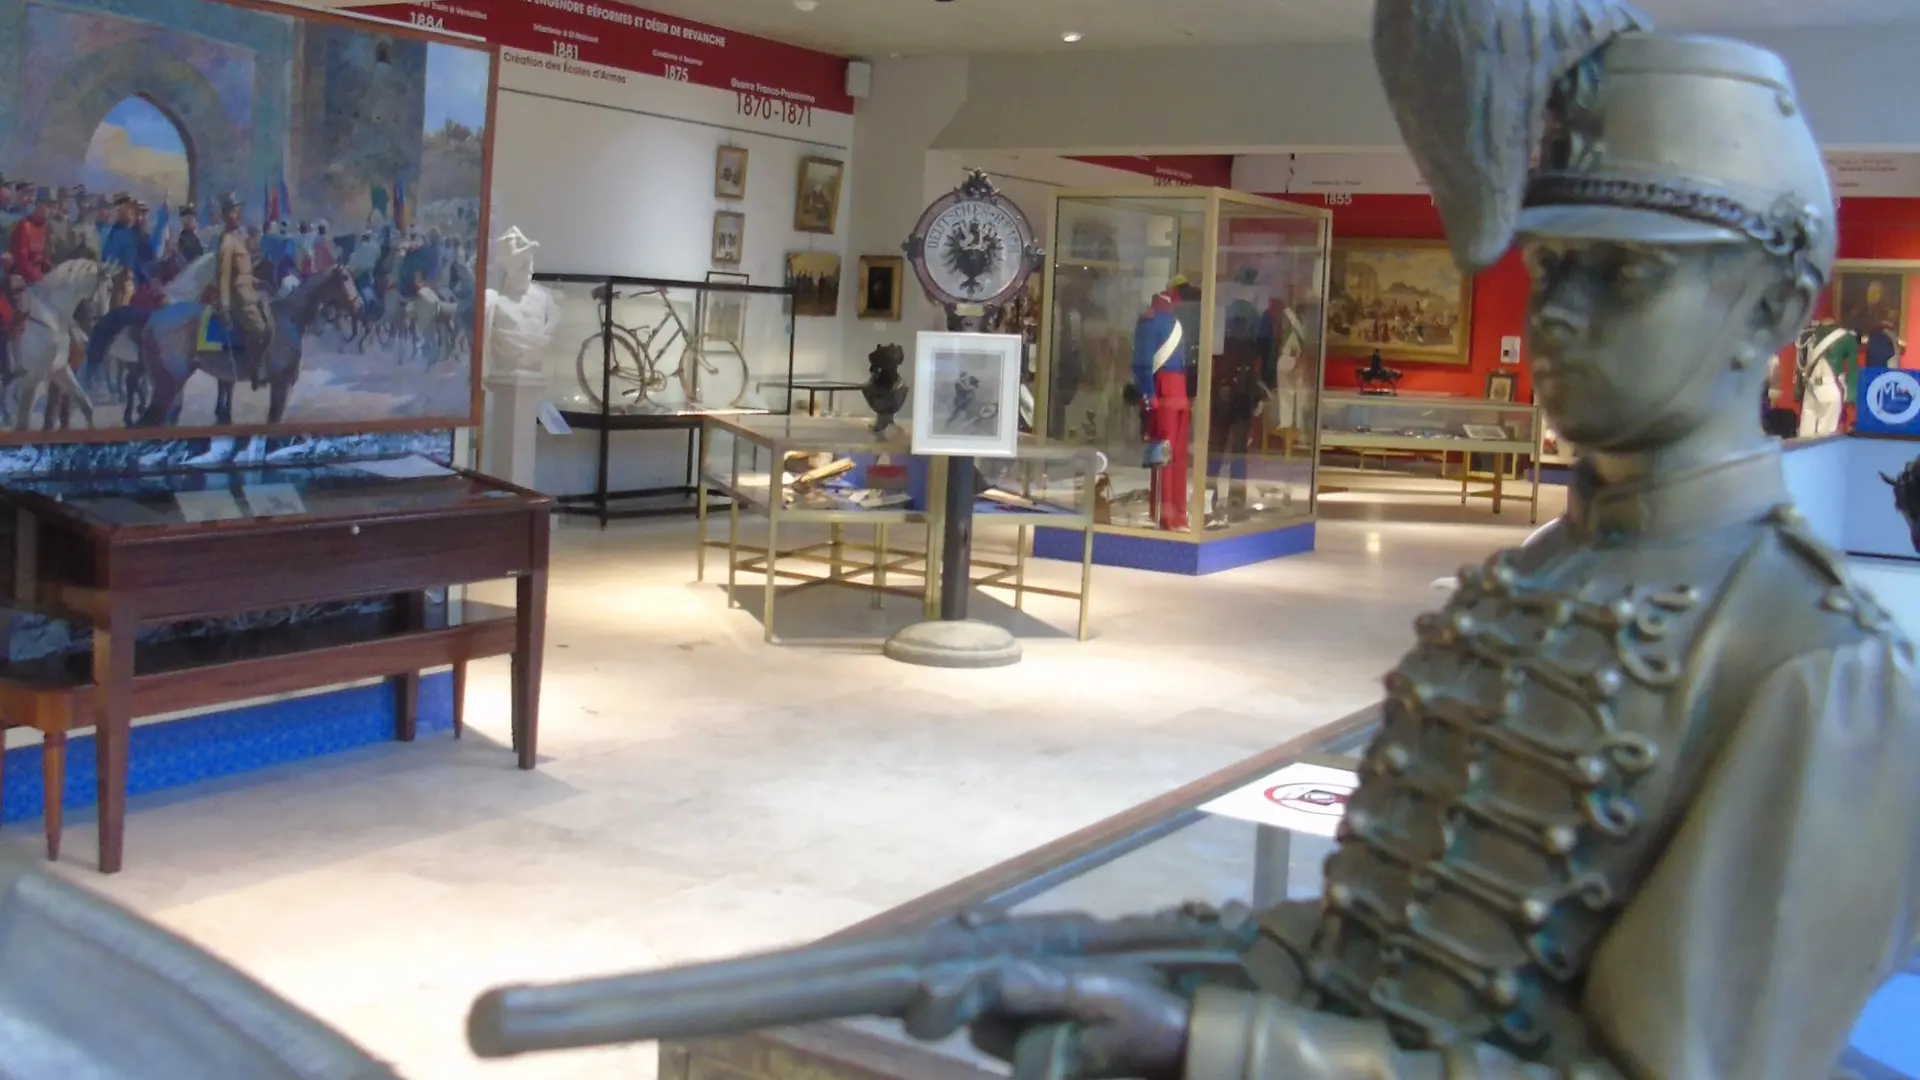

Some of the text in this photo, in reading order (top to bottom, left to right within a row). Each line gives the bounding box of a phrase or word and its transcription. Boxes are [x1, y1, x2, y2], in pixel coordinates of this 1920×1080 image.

[411, 11, 444, 30] 1884
[587, 4, 633, 26] RÉFORMES
[634, 16, 643, 28] ET
[645, 18, 669, 35] DÉSIR
[670, 24, 681, 37] DE
[683, 27, 726, 47] REVANCHE
[553, 40, 579, 60] 1881
[503, 52, 543, 68] Création
[545, 60, 561, 71] des
[664, 63, 689, 83] 1875
[736, 90, 812, 128] 1870-1871
[1323, 191, 1353, 206] 1855
